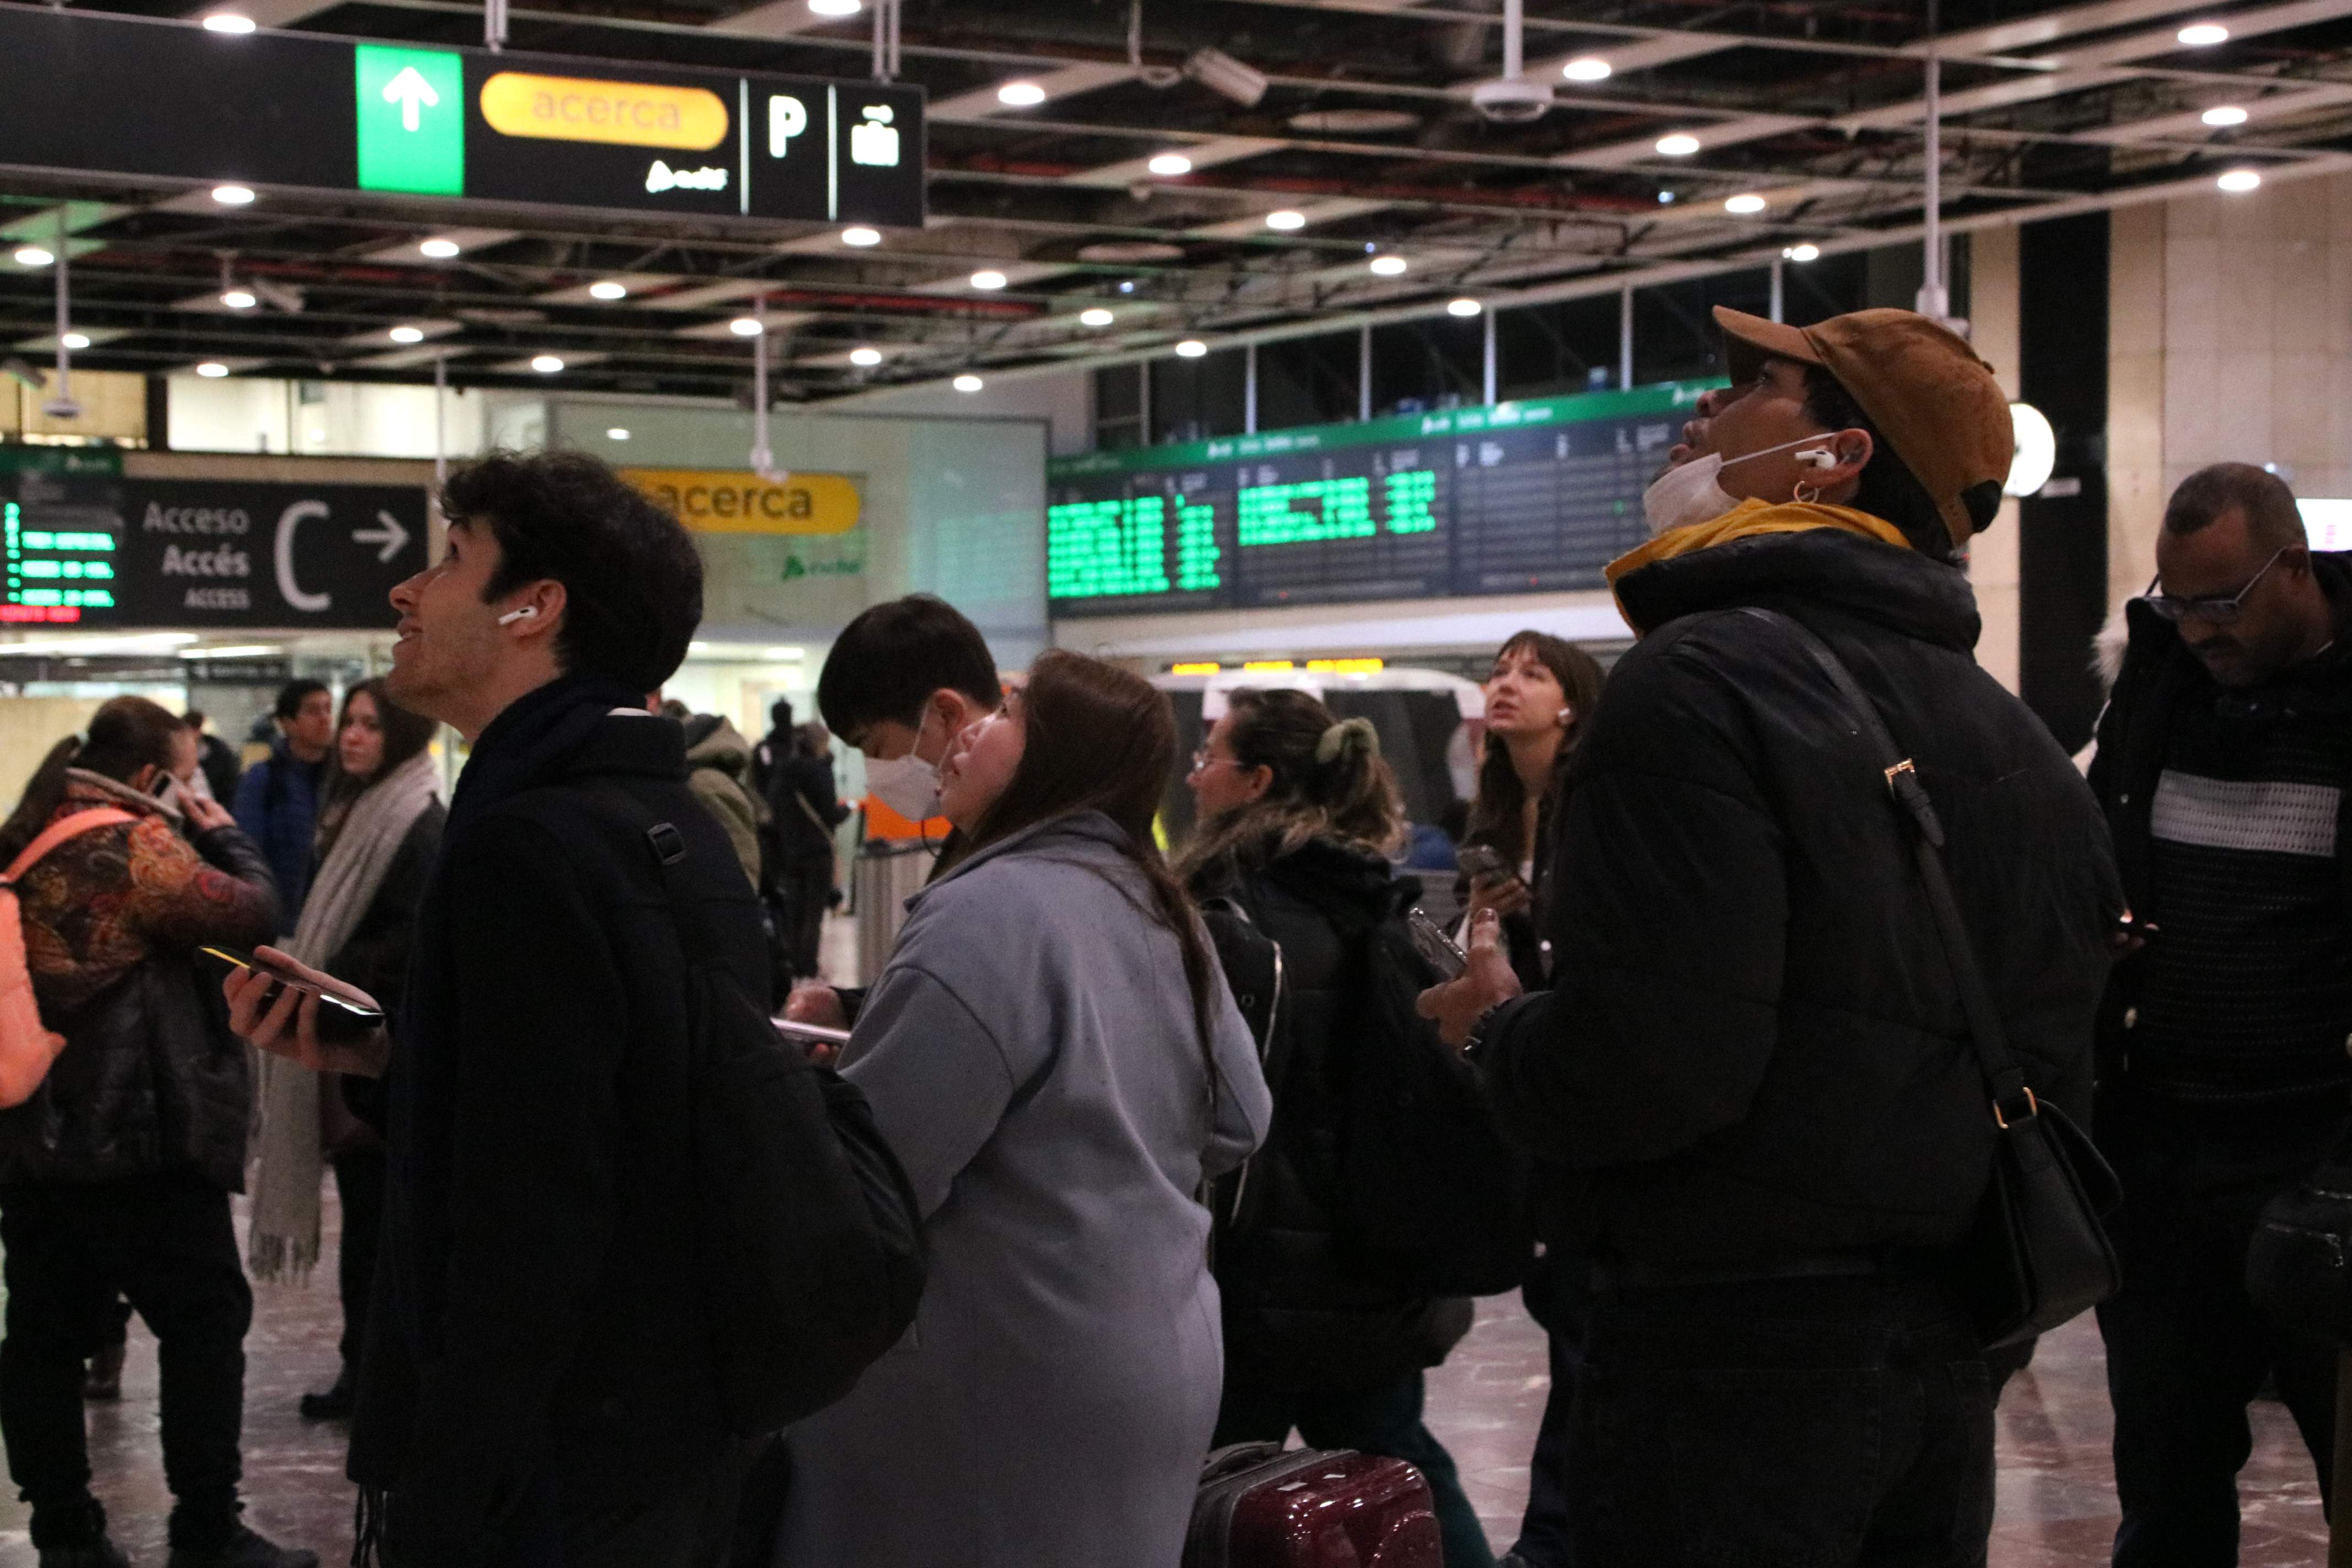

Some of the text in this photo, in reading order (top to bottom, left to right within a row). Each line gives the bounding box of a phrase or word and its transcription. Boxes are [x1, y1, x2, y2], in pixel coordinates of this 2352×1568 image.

[532, 89, 682, 130] acerca
[768, 95, 808, 158] P
[143, 502, 249, 533] Acceso
[656, 484, 812, 518] acerca
[162, 543, 249, 575] Accés
[275, 500, 330, 612] C
